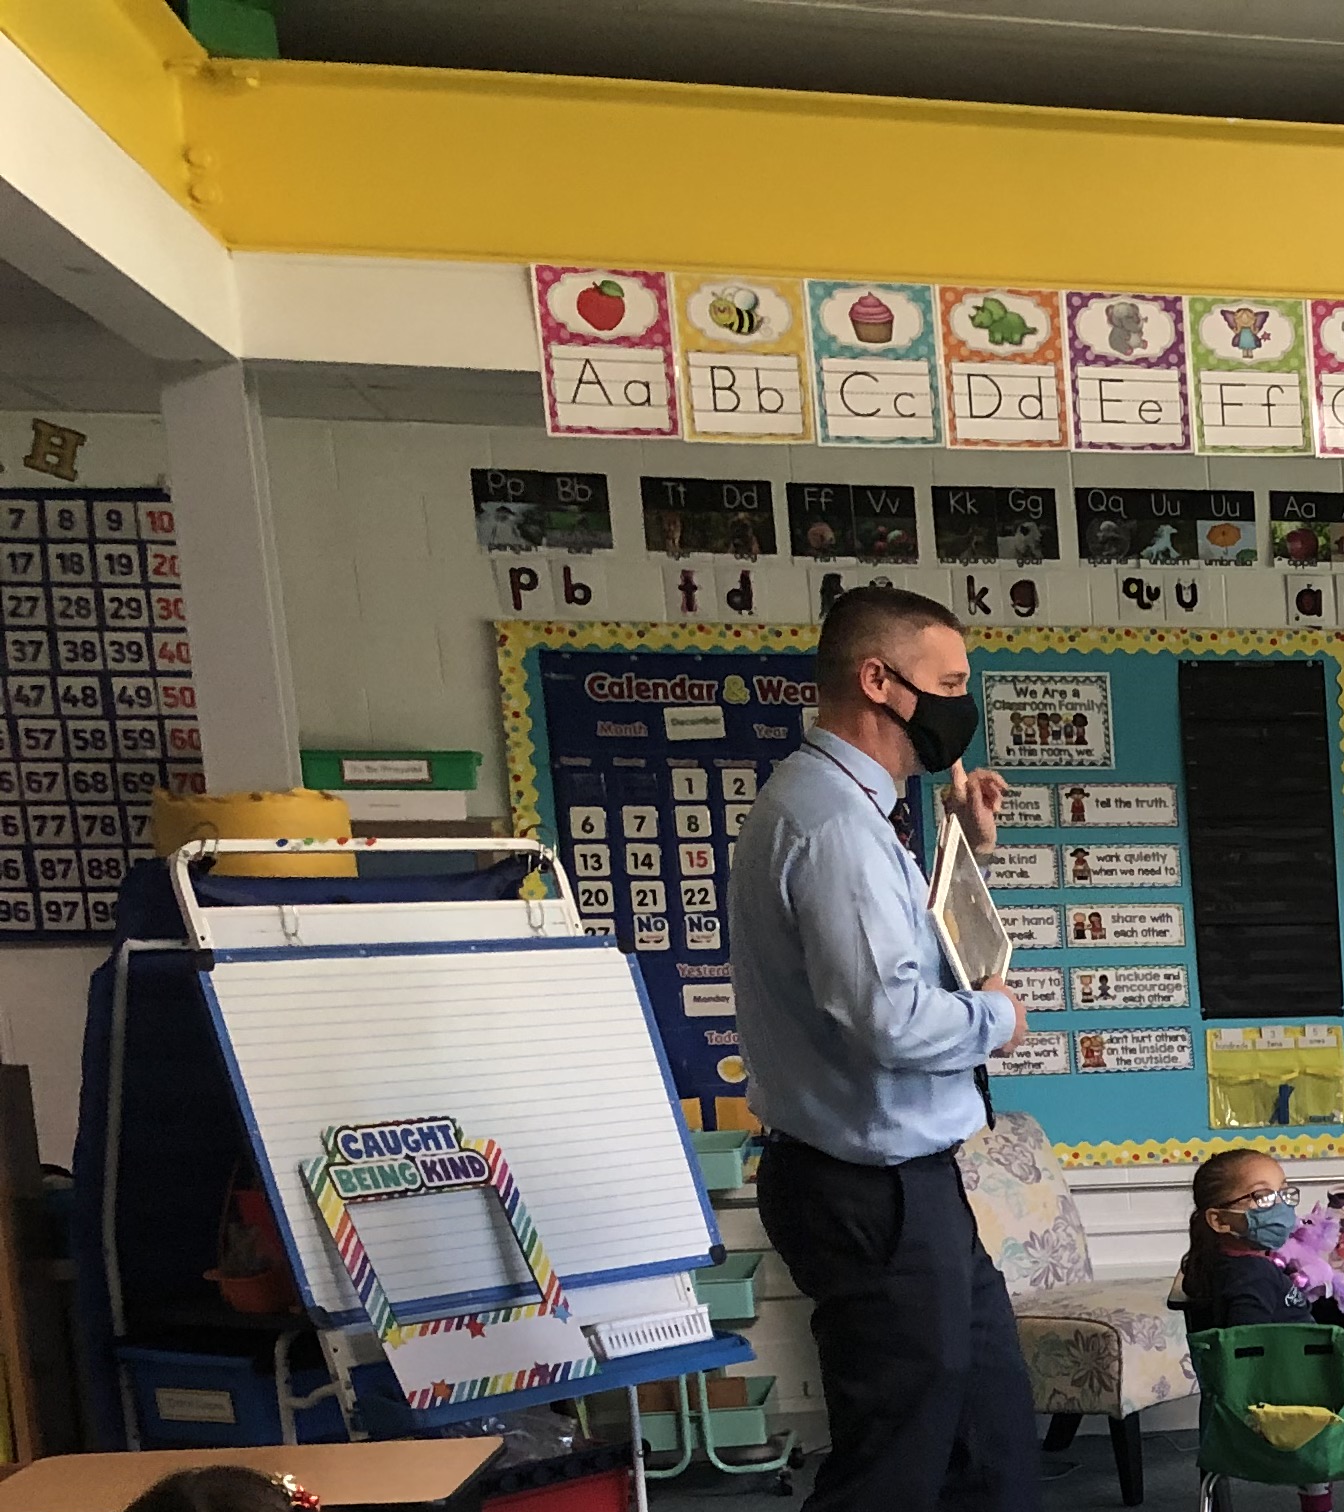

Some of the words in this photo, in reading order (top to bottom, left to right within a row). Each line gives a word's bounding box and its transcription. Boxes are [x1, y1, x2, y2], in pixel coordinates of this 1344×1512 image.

[571, 358, 652, 407] Aa
[709, 365, 785, 415] Bb
[839, 372, 916, 419] Cc
[967, 374, 1045, 420] Dd
[1099, 379, 1163, 425] Ee
[1219, 383, 1285, 427] Ff
[59, 510, 74, 530] 8
[58, 553, 84, 575] 18
[109, 598, 143, 620] 29
[63, 641, 97, 662] 38
[585, 672, 719, 703] Calendar
[722, 674, 750, 704] &
[1016, 687, 1038, 699] We
[1042, 687, 1068, 699] Are
[1071, 687, 1081, 699] a
[992, 700, 1057, 712] Classroom
[1058, 700, 1101, 713] Family
[597, 721, 649, 738] Month
[754, 724, 789, 739] Year
[24, 728, 56, 750] 57
[1019, 746, 1038, 757] this
[73, 771, 108, 794] 68
[733, 778, 746, 795] 2
[1095, 798, 1112, 809] tell
[1114, 798, 1132, 809] the
[1135, 798, 1169, 809] truth.
[33, 815, 66, 837] 77
[581, 815, 595, 834] 6
[687, 815, 700, 833] 8
[580, 853, 603, 871] 13
[685, 851, 708, 868] 15
[1008, 853, 1037, 865] kind
[1096, 852, 1121, 864] work
[1124, 851, 1168, 864] quietly
[1091, 866, 1118, 877] when
[1120, 867, 1135, 877] we
[1137, 866, 1162, 877] need
[582, 889, 609, 907] 20
[683, 888, 710, 906] 22
[638, 916, 666, 933] No
[689, 916, 717, 933] No
[1110, 912, 1147, 925] share
[1150, 912, 1173, 924] with
[1113, 928, 1138, 939] each
[677, 963, 731, 978] Yesterd
[1115, 970, 1161, 982] include
[1163, 972, 1181, 982] and
[1114, 982, 1182, 995] encourage
[693, 995, 730, 1005] Monday
[704, 1031, 740, 1046] Toda
[1131, 1032, 1153, 1044] hurt
[1155, 1032, 1187, 1043] others
[1120, 1044, 1138, 1056] the
[1139, 1042, 1174, 1054] inside
[1116, 1055, 1132, 1066] the
[340, 1123, 456, 1160] CAUGHT
[334, 1161, 419, 1193] BEING
[420, 1155, 486, 1184] KIND
